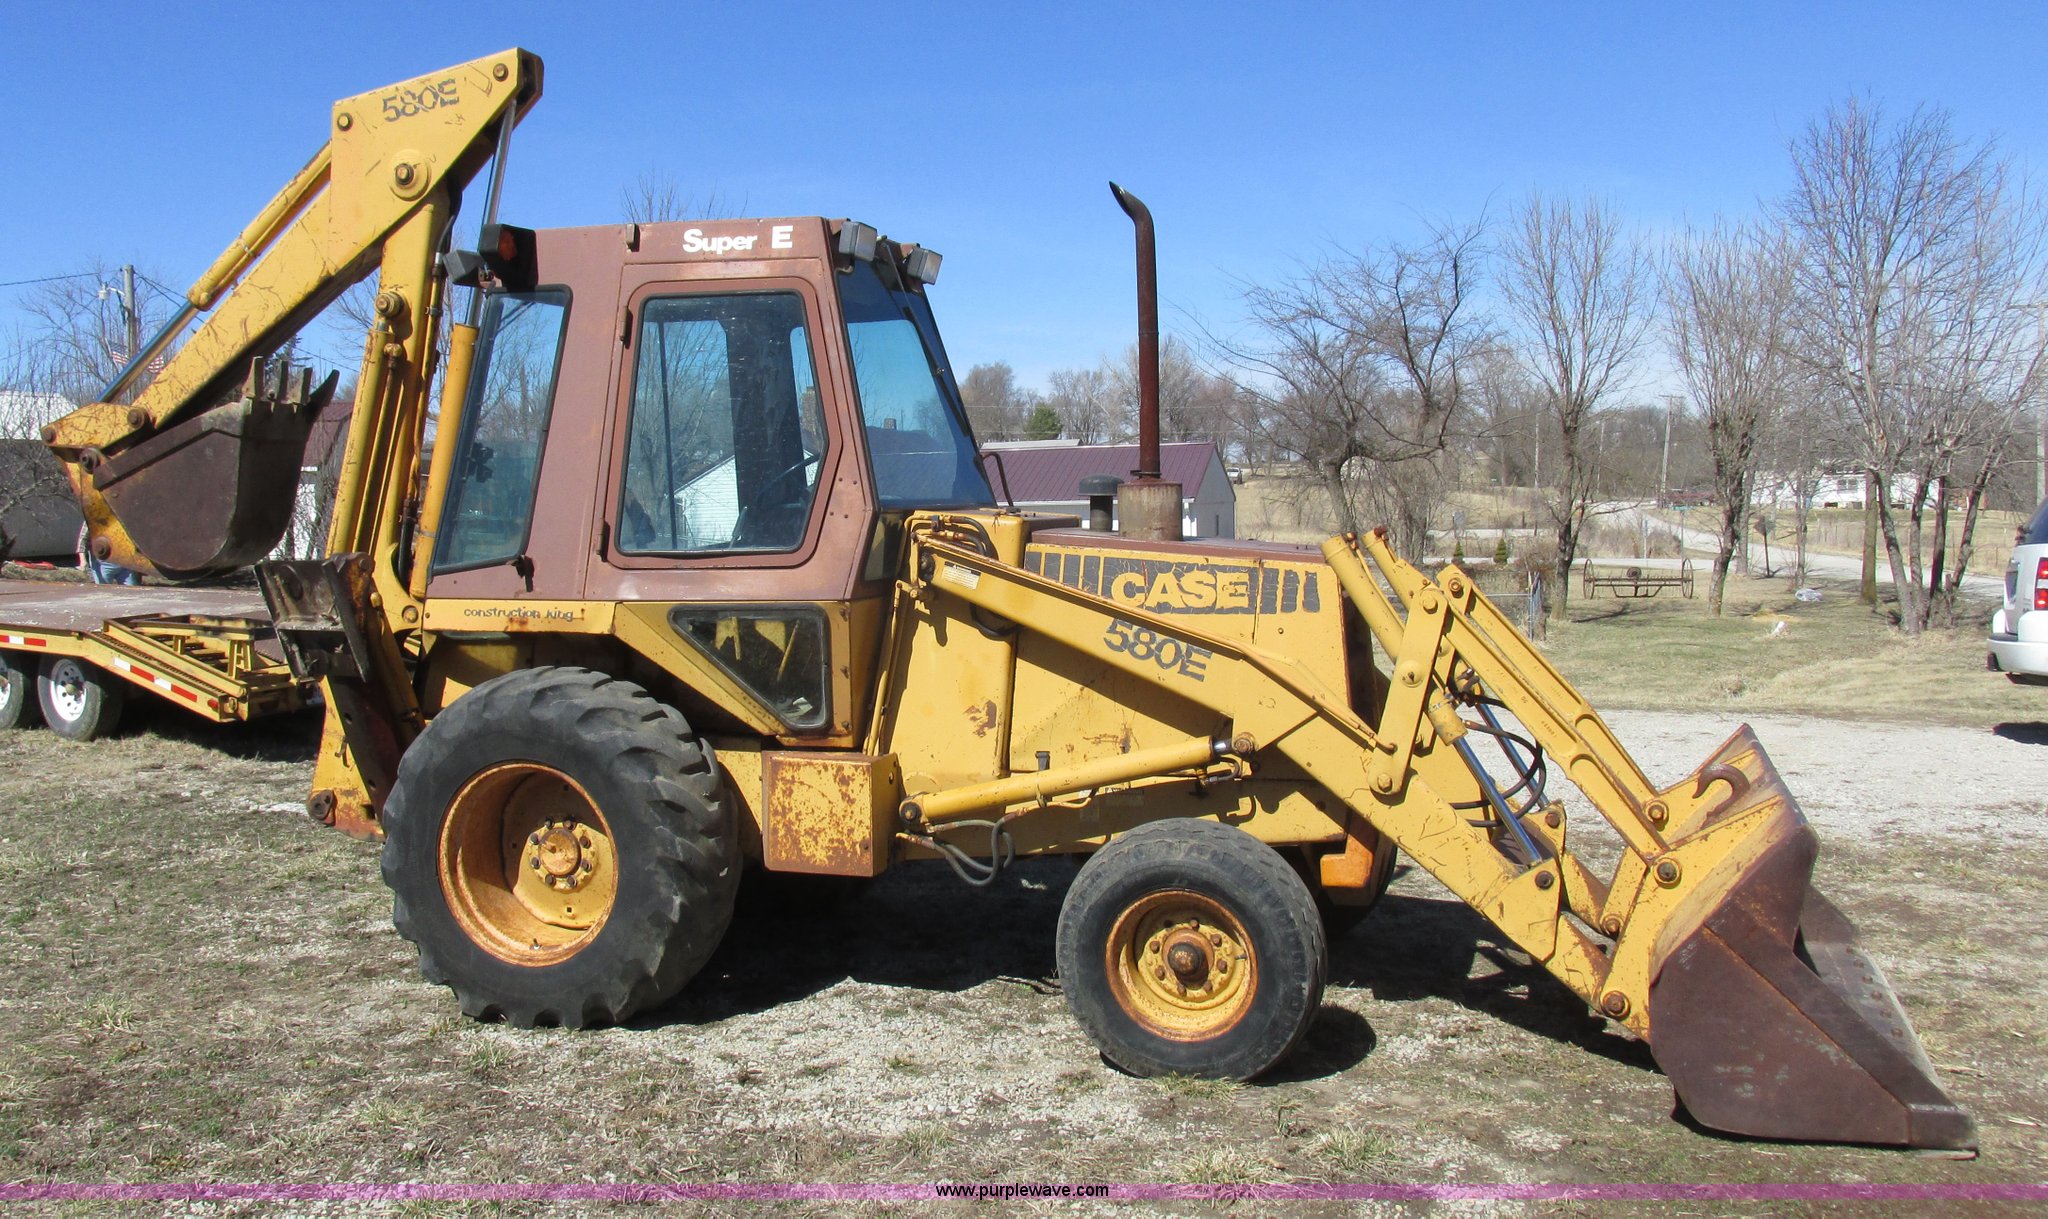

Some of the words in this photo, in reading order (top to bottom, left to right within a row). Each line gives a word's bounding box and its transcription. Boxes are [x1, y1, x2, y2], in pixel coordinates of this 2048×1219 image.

[382, 78, 460, 122] 580E
[683, 228, 757, 255] Super
[771, 225, 794, 249] E
[1111, 570, 1250, 610] CASE
[464, 607, 541, 619] construction
[1103, 618, 1214, 682] 580E
